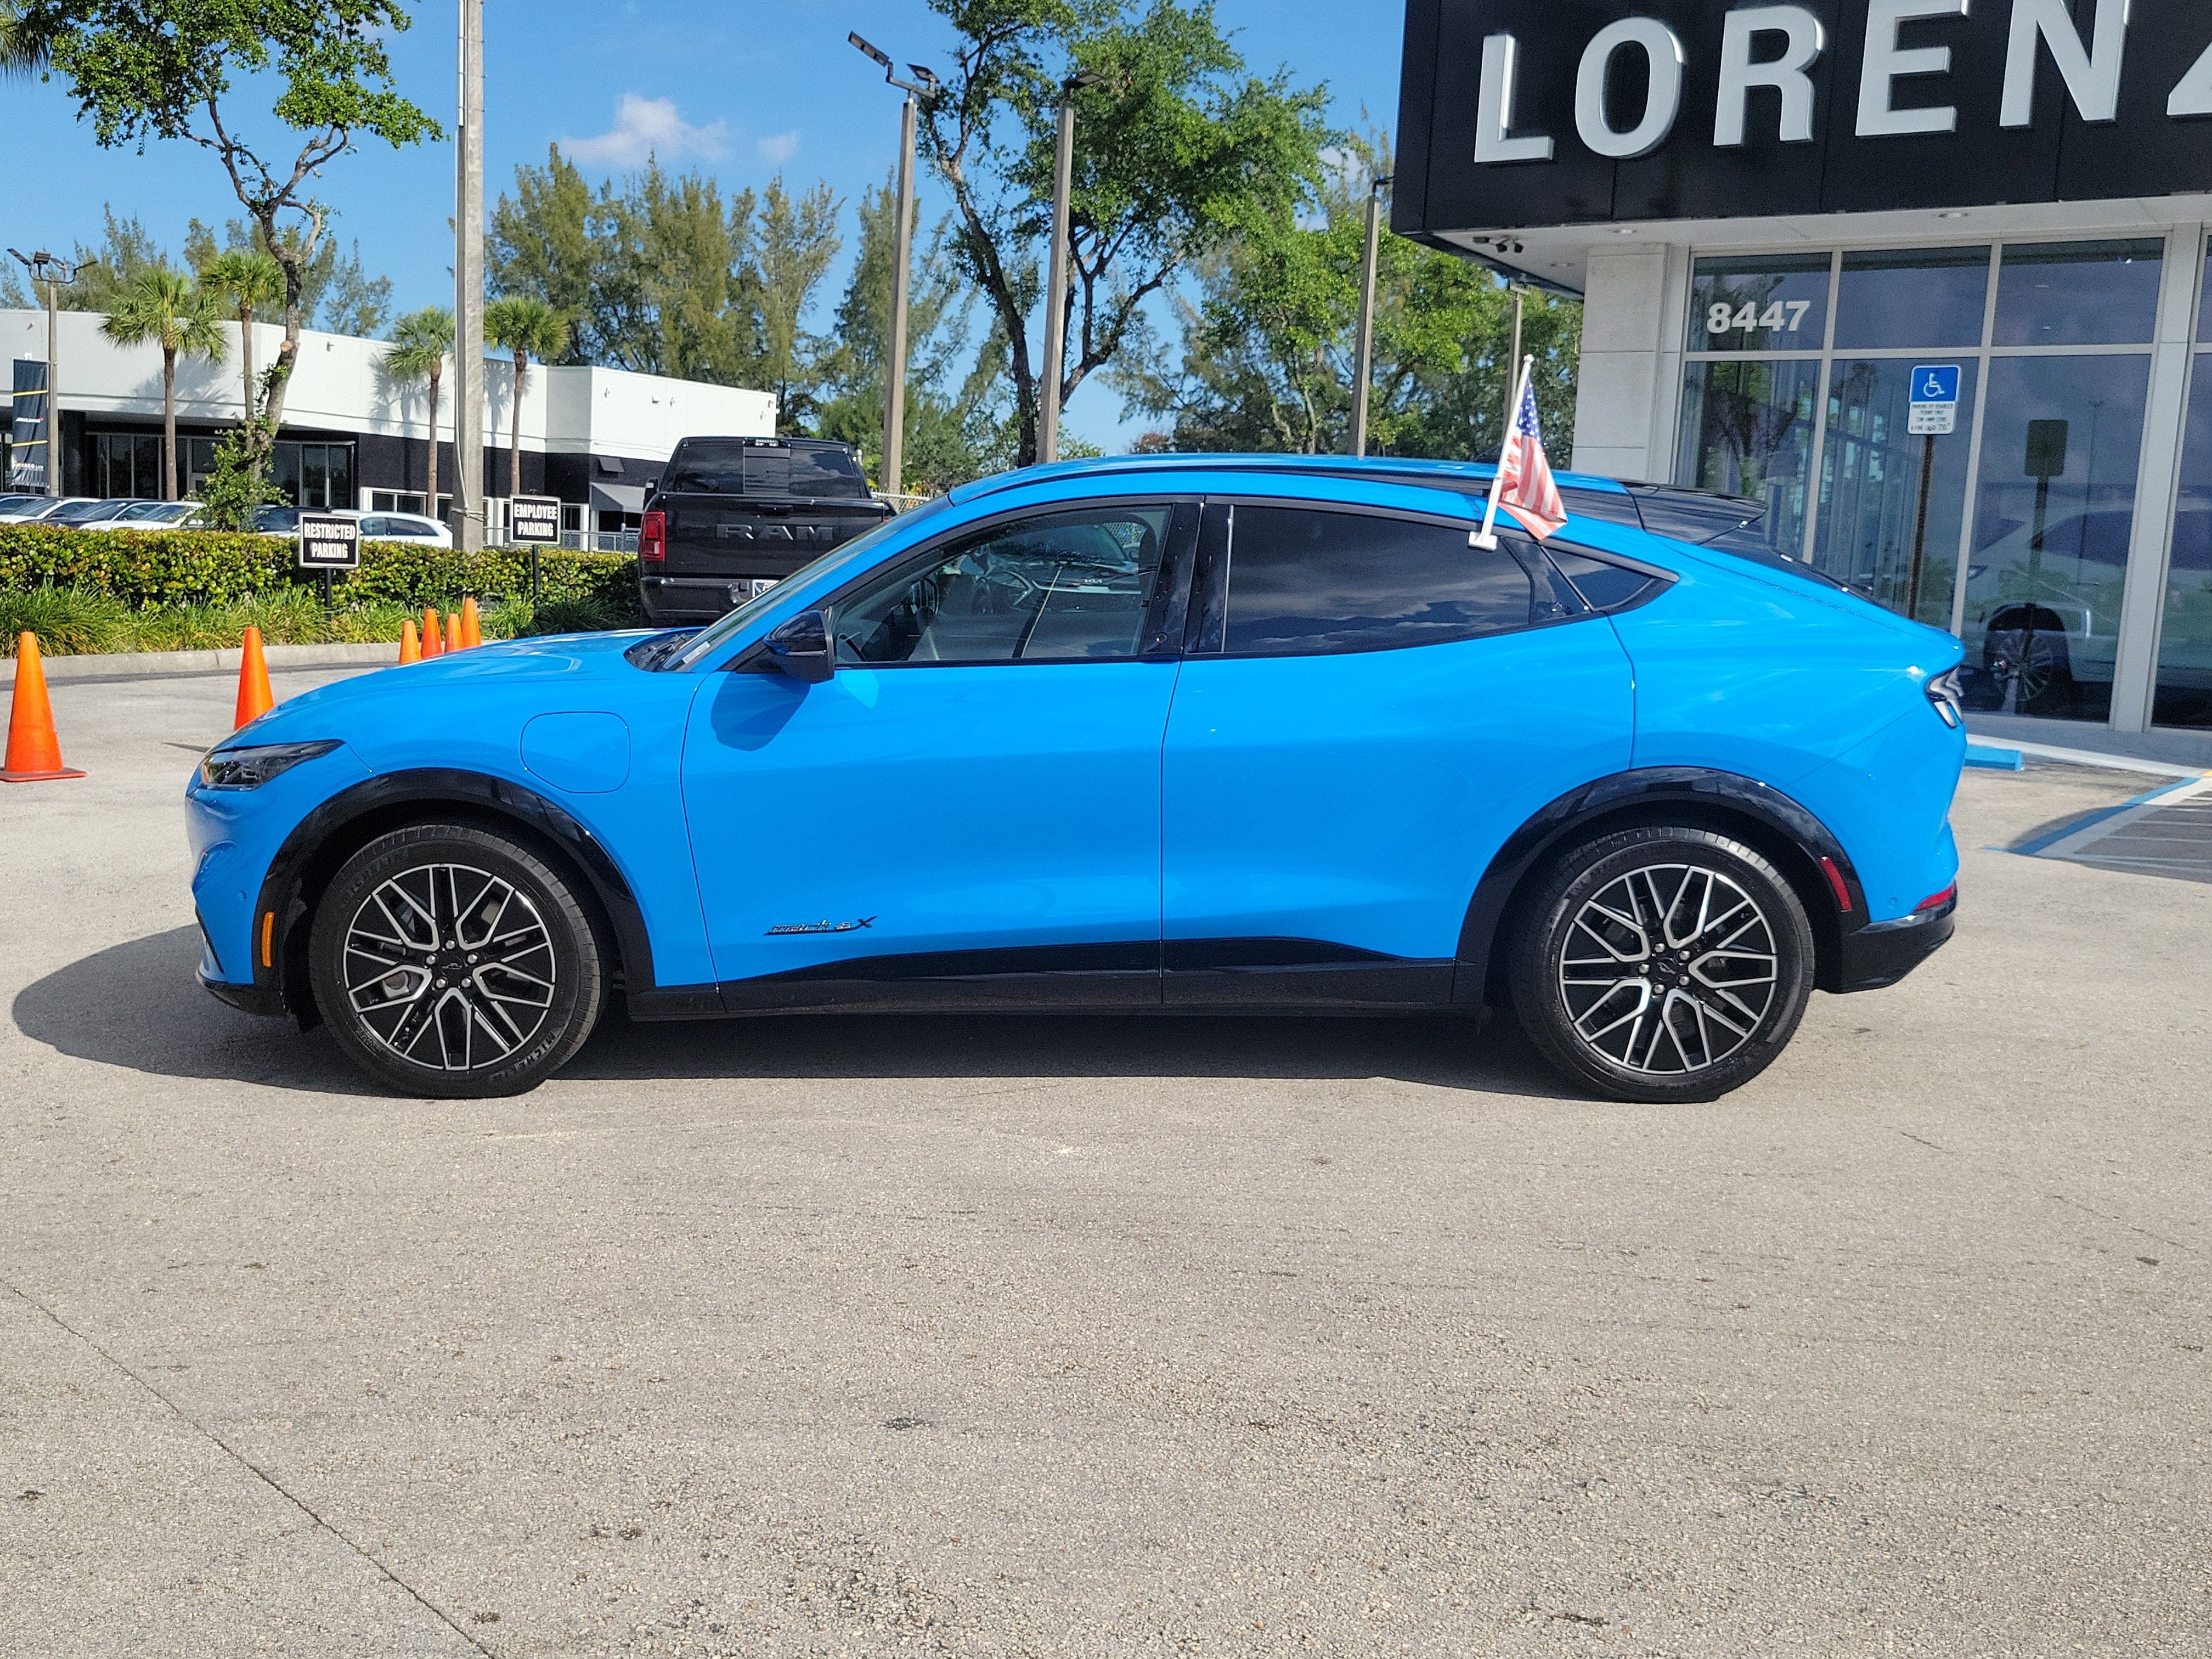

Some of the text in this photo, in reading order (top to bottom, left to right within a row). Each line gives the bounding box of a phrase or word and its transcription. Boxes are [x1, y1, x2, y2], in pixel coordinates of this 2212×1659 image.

[1707, 300, 1810, 334] 8447
[514, 503, 557, 520] EMPLOYEE
[304, 523, 356, 540] RESTRICTED
[517, 521, 554, 537] PARKING
[716, 523, 833, 540] RAM
[311, 542, 348, 558] PARKING
